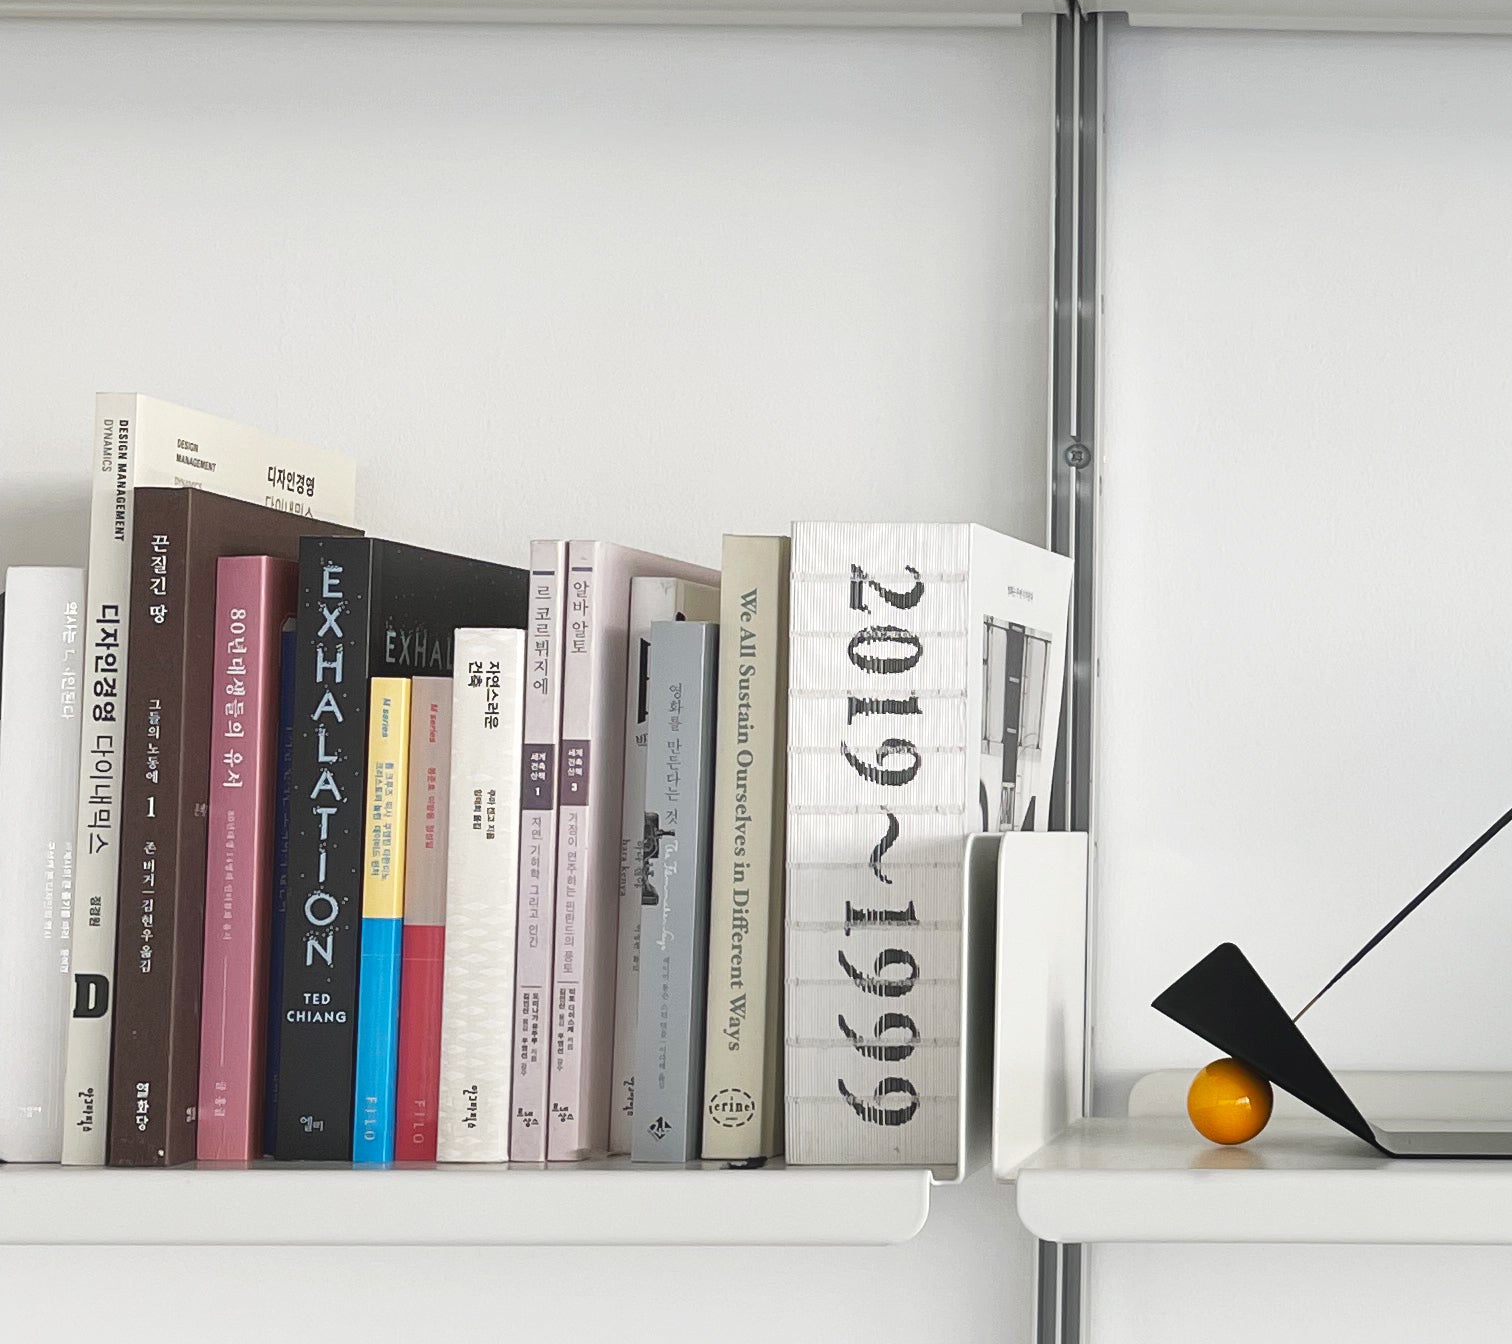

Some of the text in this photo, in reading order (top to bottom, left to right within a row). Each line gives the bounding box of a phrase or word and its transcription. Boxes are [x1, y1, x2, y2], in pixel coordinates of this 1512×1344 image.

[100, 418, 115, 473] DYNAMICS
[177, 438, 199, 453] DESIGN
[112, 419, 129, 542] DESIGN MANAGEMENT
[266, 465, 316, 498] 디자인경영
[149, 534, 169, 625] 끈질긴 땅
[569, 580, 590, 654] 알바 알토
[224, 607, 248, 739] 80년대생들의
[467, 660, 483, 688] 건축
[482, 660, 501, 730] 자연스러운
[86, 604, 121, 856] 디자인경영 다이내믹스
[146, 698, 162, 740] 그들의
[220, 748, 244, 788] 유서
[302, 560, 346, 968] EXHALATION
[663, 682, 684, 825] 영화를 만든다는 것
[144, 797, 158, 818] 1
[723, 588, 759, 1051] We All Sustain Ourselves in Different Ways
[836, 563, 925, 1128] 2019~1999
[87, 895, 103, 928] 정경원
[285, 1009, 348, 1025] CHIANG
[302, 993, 331, 1006] TED
[76, 1087, 96, 1133] 안그라픽스
[134, 1082, 151, 1132] 열화당
[362, 1096, 378, 1141] FILO
[410, 1099, 426, 1145] FILO
[460, 1084, 478, 1129] 안그라픽스
